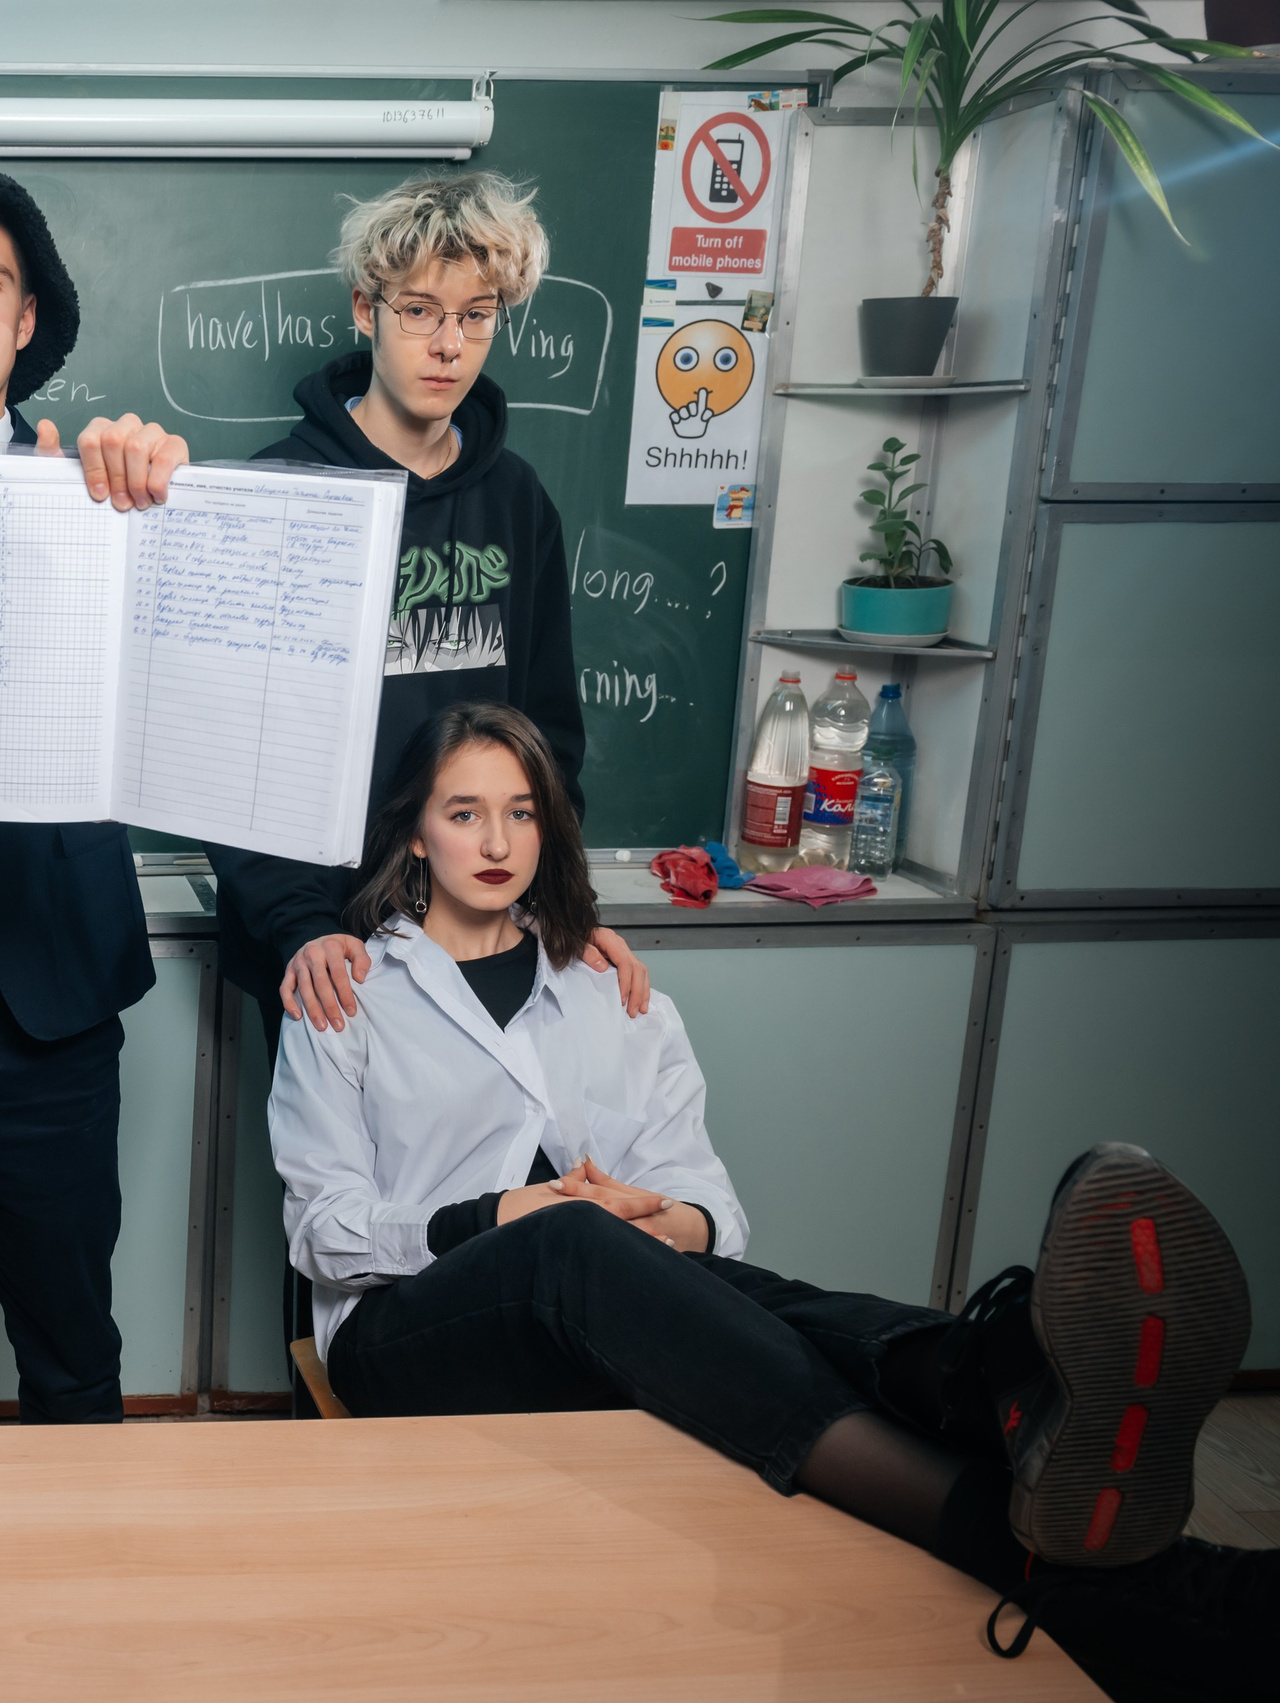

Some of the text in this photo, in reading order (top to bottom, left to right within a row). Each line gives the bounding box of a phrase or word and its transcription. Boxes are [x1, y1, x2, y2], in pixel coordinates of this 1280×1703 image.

[695, 234, 743, 248] Turn off
[671, 254, 762, 270] mobile phones
[645, 446, 748, 470] Shhhhh!
